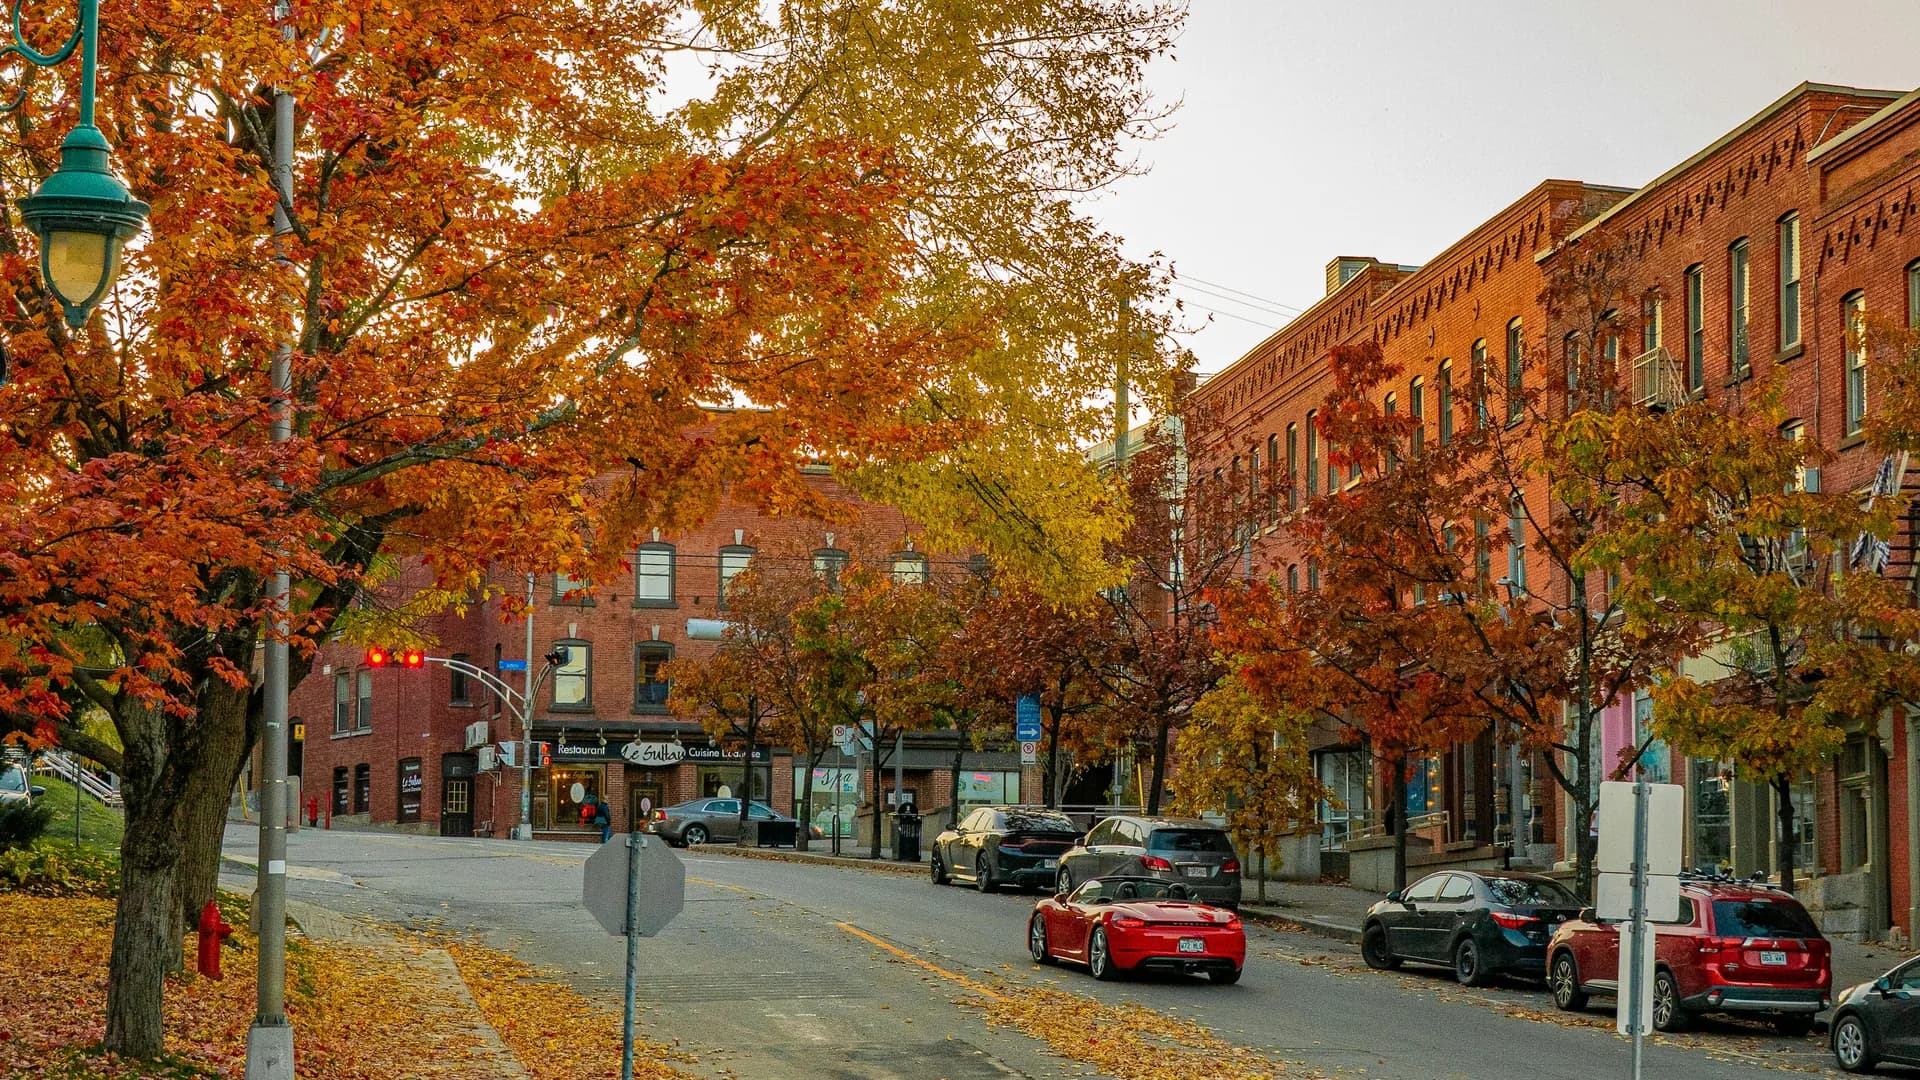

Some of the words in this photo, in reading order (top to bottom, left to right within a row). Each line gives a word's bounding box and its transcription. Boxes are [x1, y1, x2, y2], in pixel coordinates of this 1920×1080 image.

[558, 744, 605, 755] Restaurant
[622, 745, 640, 761] Le
[643, 743, 686, 761] Sultan
[688, 747, 720, 758] Cuisine
